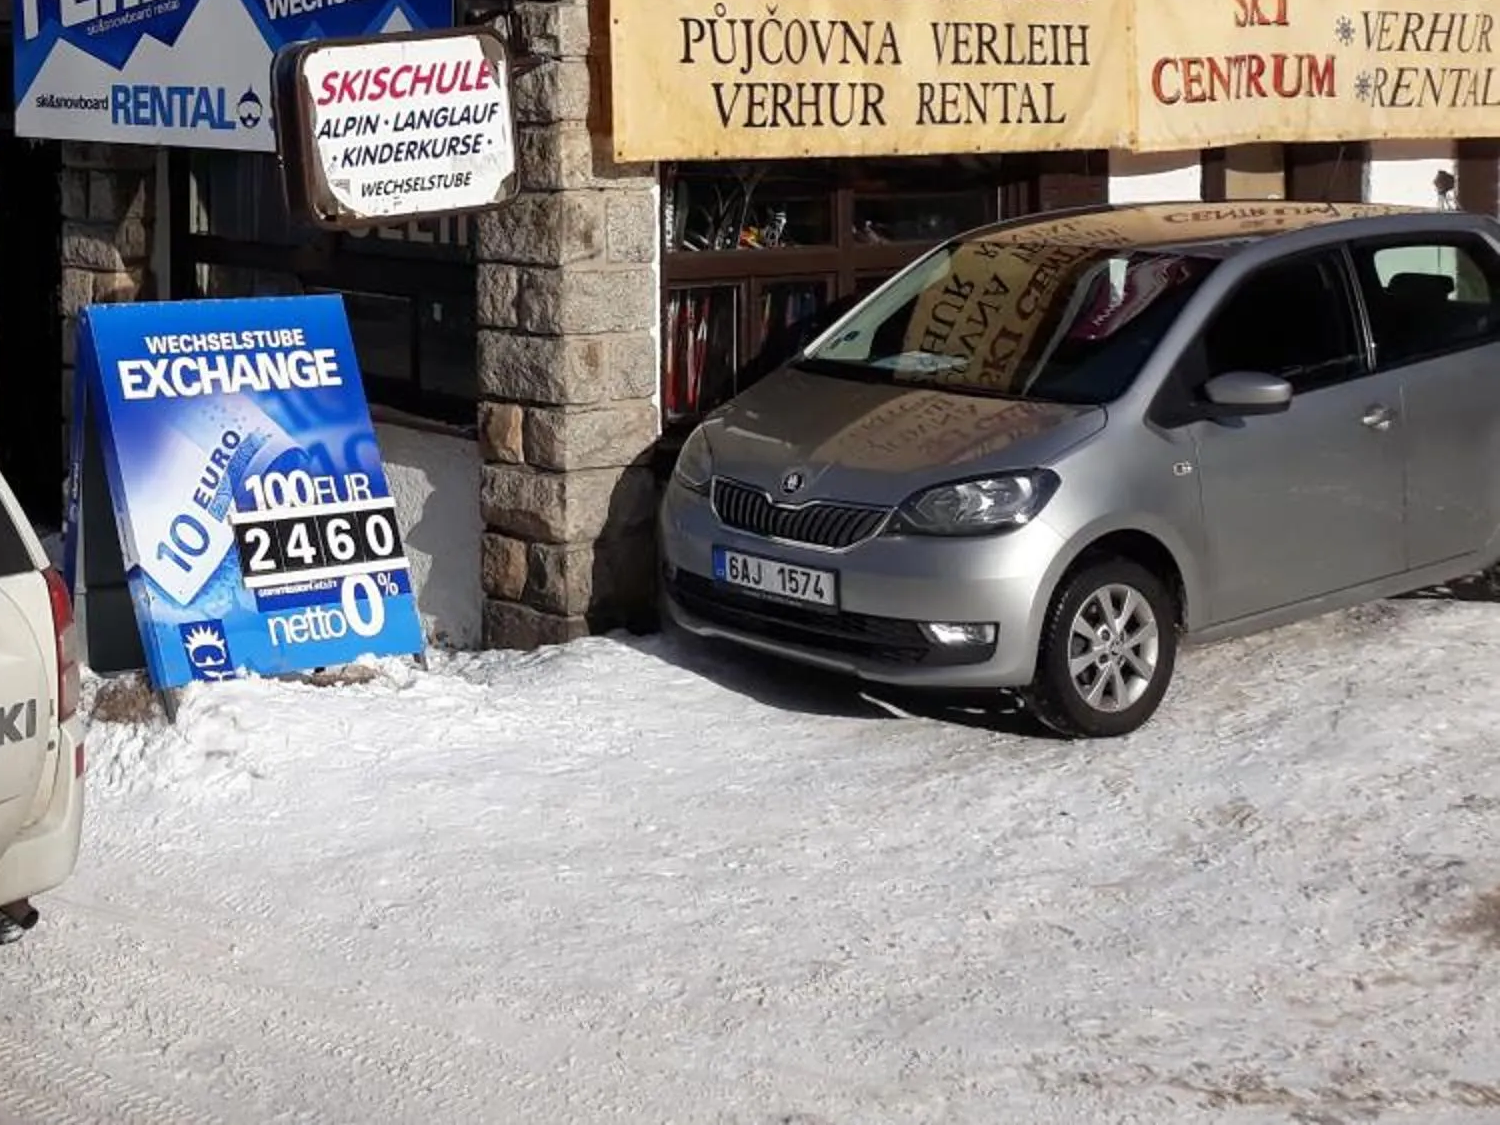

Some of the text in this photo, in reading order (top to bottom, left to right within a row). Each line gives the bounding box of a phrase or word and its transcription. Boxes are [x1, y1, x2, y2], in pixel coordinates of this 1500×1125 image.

[678, 2, 1091, 75] PŮJČOVNA VERLEIH
[1361, 10, 1494, 54] VERHUR
[317, 59, 493, 106] SKISCHULE
[1151, 52, 1338, 106] CENTRUM
[1370, 66, 1500, 108] RENTAL
[36, 84, 237, 130] ski&snowboard RENTAL
[318, 102, 500, 140] ALPIN LANGLAUF
[711, 81, 1067, 129] VERHUR RENTAL
[341, 133, 485, 169] KINDERKURSE
[361, 171, 473, 198] WECHSELSTUBE
[144, 328, 305, 355] WECHSELSTUBE
[117, 349, 343, 401] EXCHANGE
[193, 429, 241, 512] EURO
[156, 512, 212, 574] 10
[244, 514, 395, 572] 2460
[729, 556, 763, 585] 6AJ
[777, 567, 825, 599] 1574
[267, 606, 347, 647] netto
